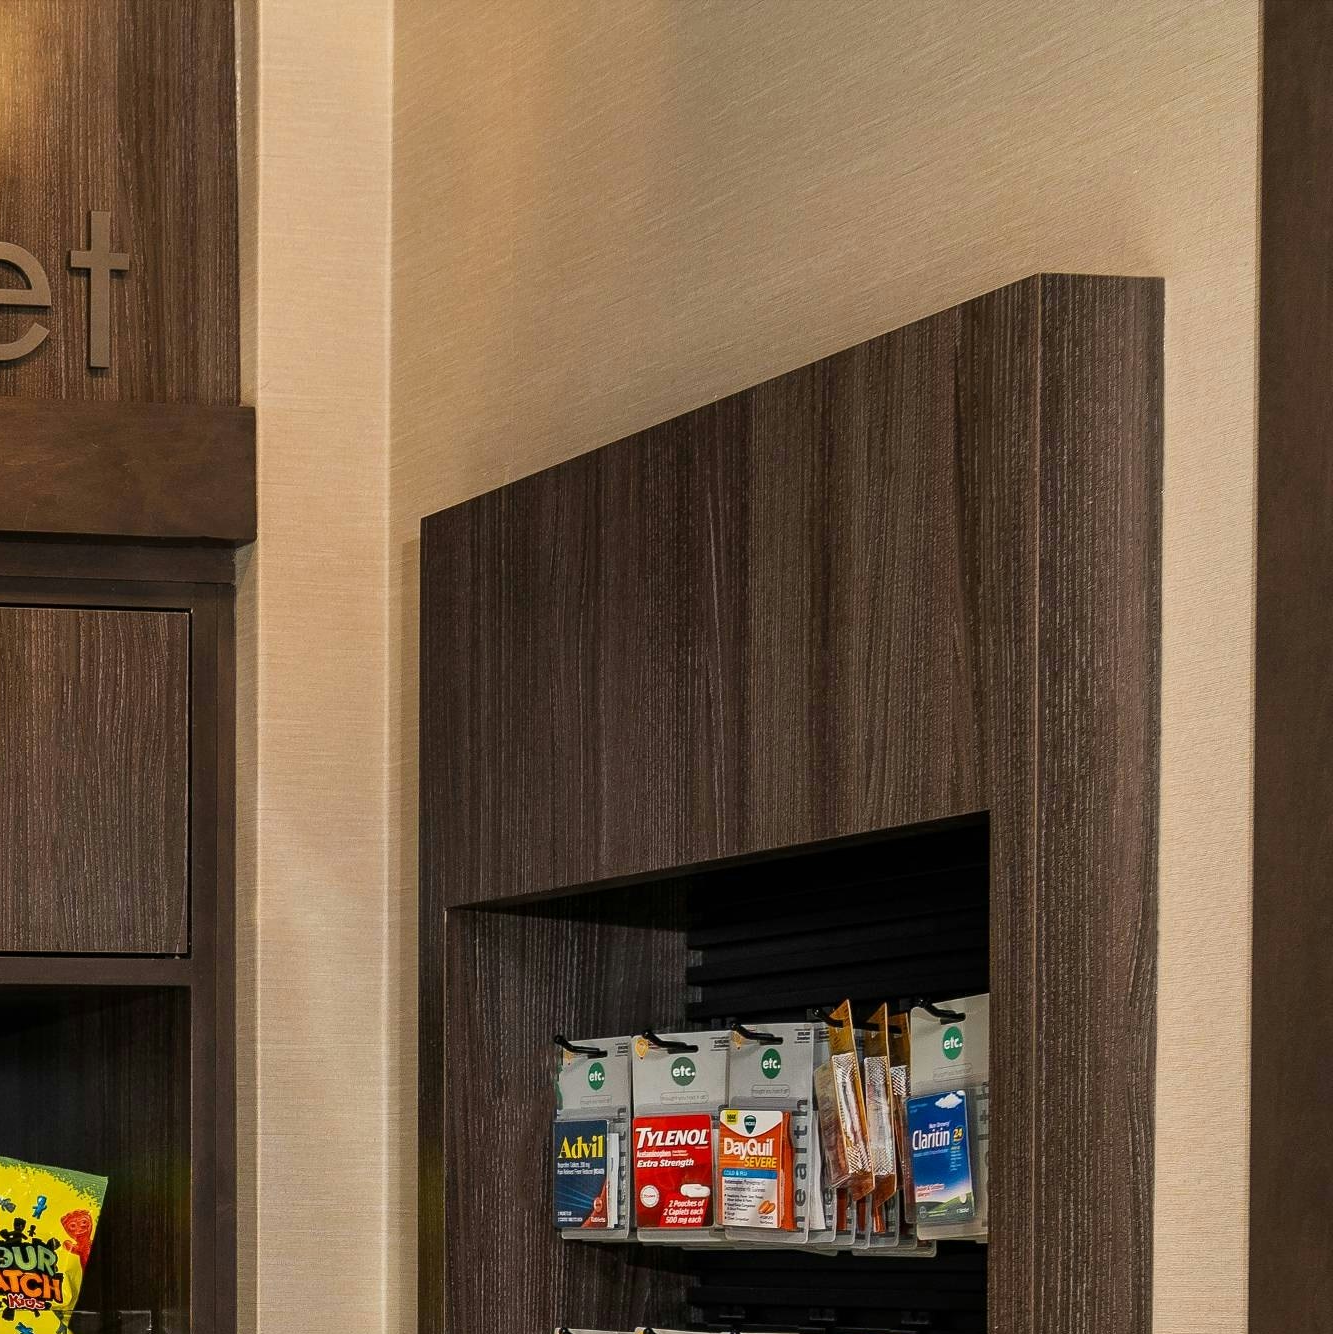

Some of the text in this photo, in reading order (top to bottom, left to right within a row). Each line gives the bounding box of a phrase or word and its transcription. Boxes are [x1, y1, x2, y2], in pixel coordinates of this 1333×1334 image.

[944, 1037, 963, 1049] etc.
[763, 1059, 781, 1069] etc.
[673, 1066, 696, 1076] etc.
[636, 1128, 709, 1149] TYLENOL
[912, 1128, 950, 1151] Claritin
[557, 1136, 605, 1159] Advil
[724, 1138, 774, 1160] DayQuil
[637, 1159, 695, 1168] Extra Strength
[745, 1157, 778, 1168] SEVERE
